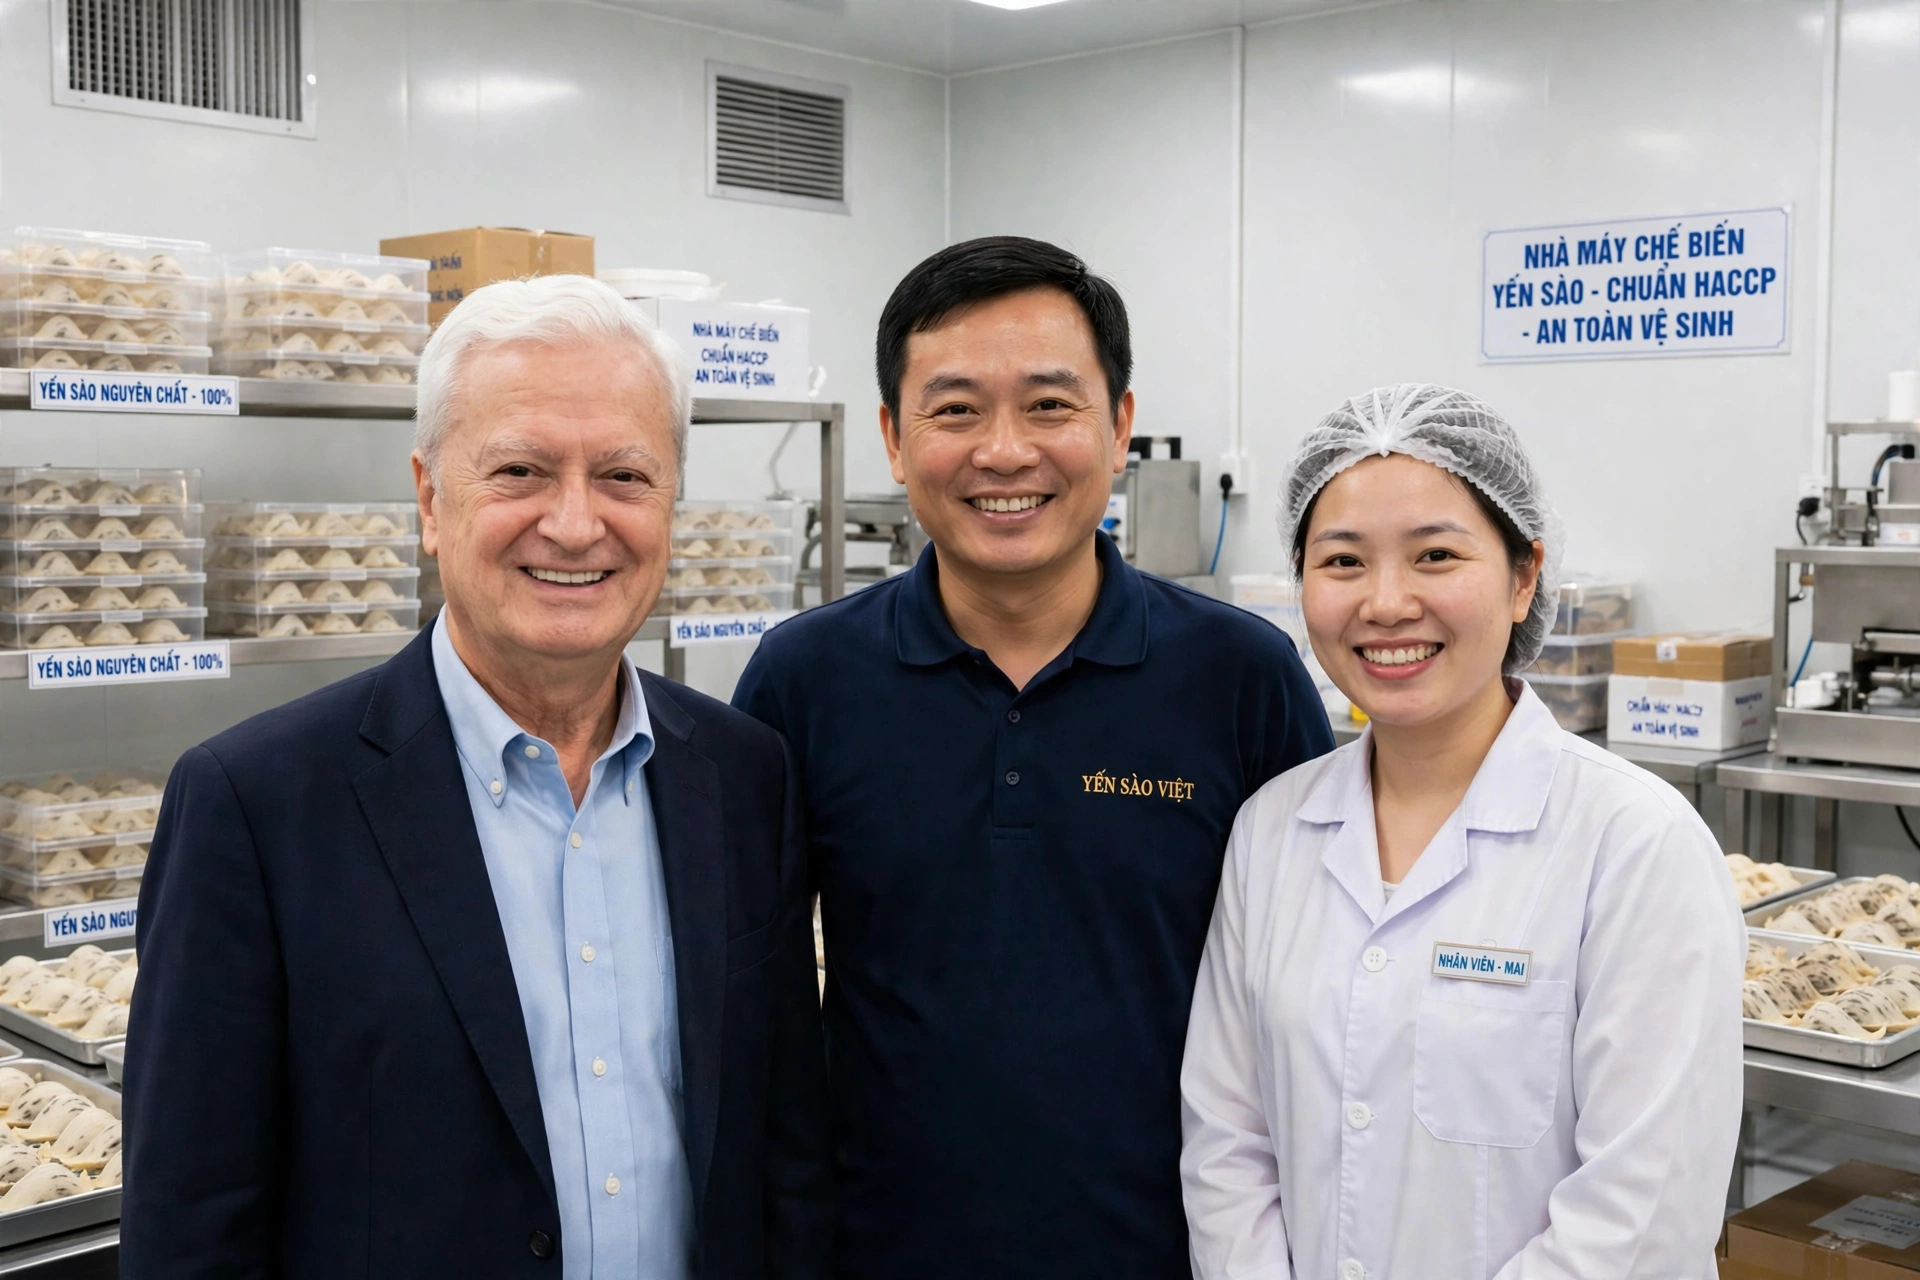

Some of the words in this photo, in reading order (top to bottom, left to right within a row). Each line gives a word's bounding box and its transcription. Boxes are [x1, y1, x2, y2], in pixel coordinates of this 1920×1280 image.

[1524, 236, 1570, 269] NHÀ
[1577, 232, 1627, 266] MÁY
[1635, 223, 1682, 261] CHẾ
[1689, 219, 1744, 258] BIẾN
[1492, 273, 1533, 309] YẾN
[1541, 274, 1584, 307] SÀO
[1607, 261, 1686, 303] CHUẨN
[1695, 267, 1776, 298] HACCP
[1537, 318, 1566, 344] AN
[1573, 309, 1633, 343] TOÀN
[1641, 307, 1668, 346] VỆ
[1675, 310, 1734, 339] SINH
[40, 375, 66, 400] YẾN
[70, 378, 96, 401] SÀO
[101, 381, 152, 403] NGUYÊN
[157, 379, 188, 404] CHẤT
[200, 388, 232, 405] 100%
[695, 368, 709, 383] AN
[37, 655, 62, 679] YẾN
[67, 656, 92, 677] SÀO
[96, 653, 146, 676] NGUYÊN
[151, 649, 180, 672] CHẤT
[192, 653, 223, 670] 100%
[1082, 768, 1117, 794] YẾN
[1120, 773, 1153, 796] SÀO
[1158, 777, 1195, 803] VIỆT
[52, 912, 78, 937] YẾN
[81, 911, 106, 933] SÀO
[1438, 952, 1468, 970] NHÂN
[1471, 955, 1495, 972] VIÊN
[1504, 961, 1525, 976] MAI
